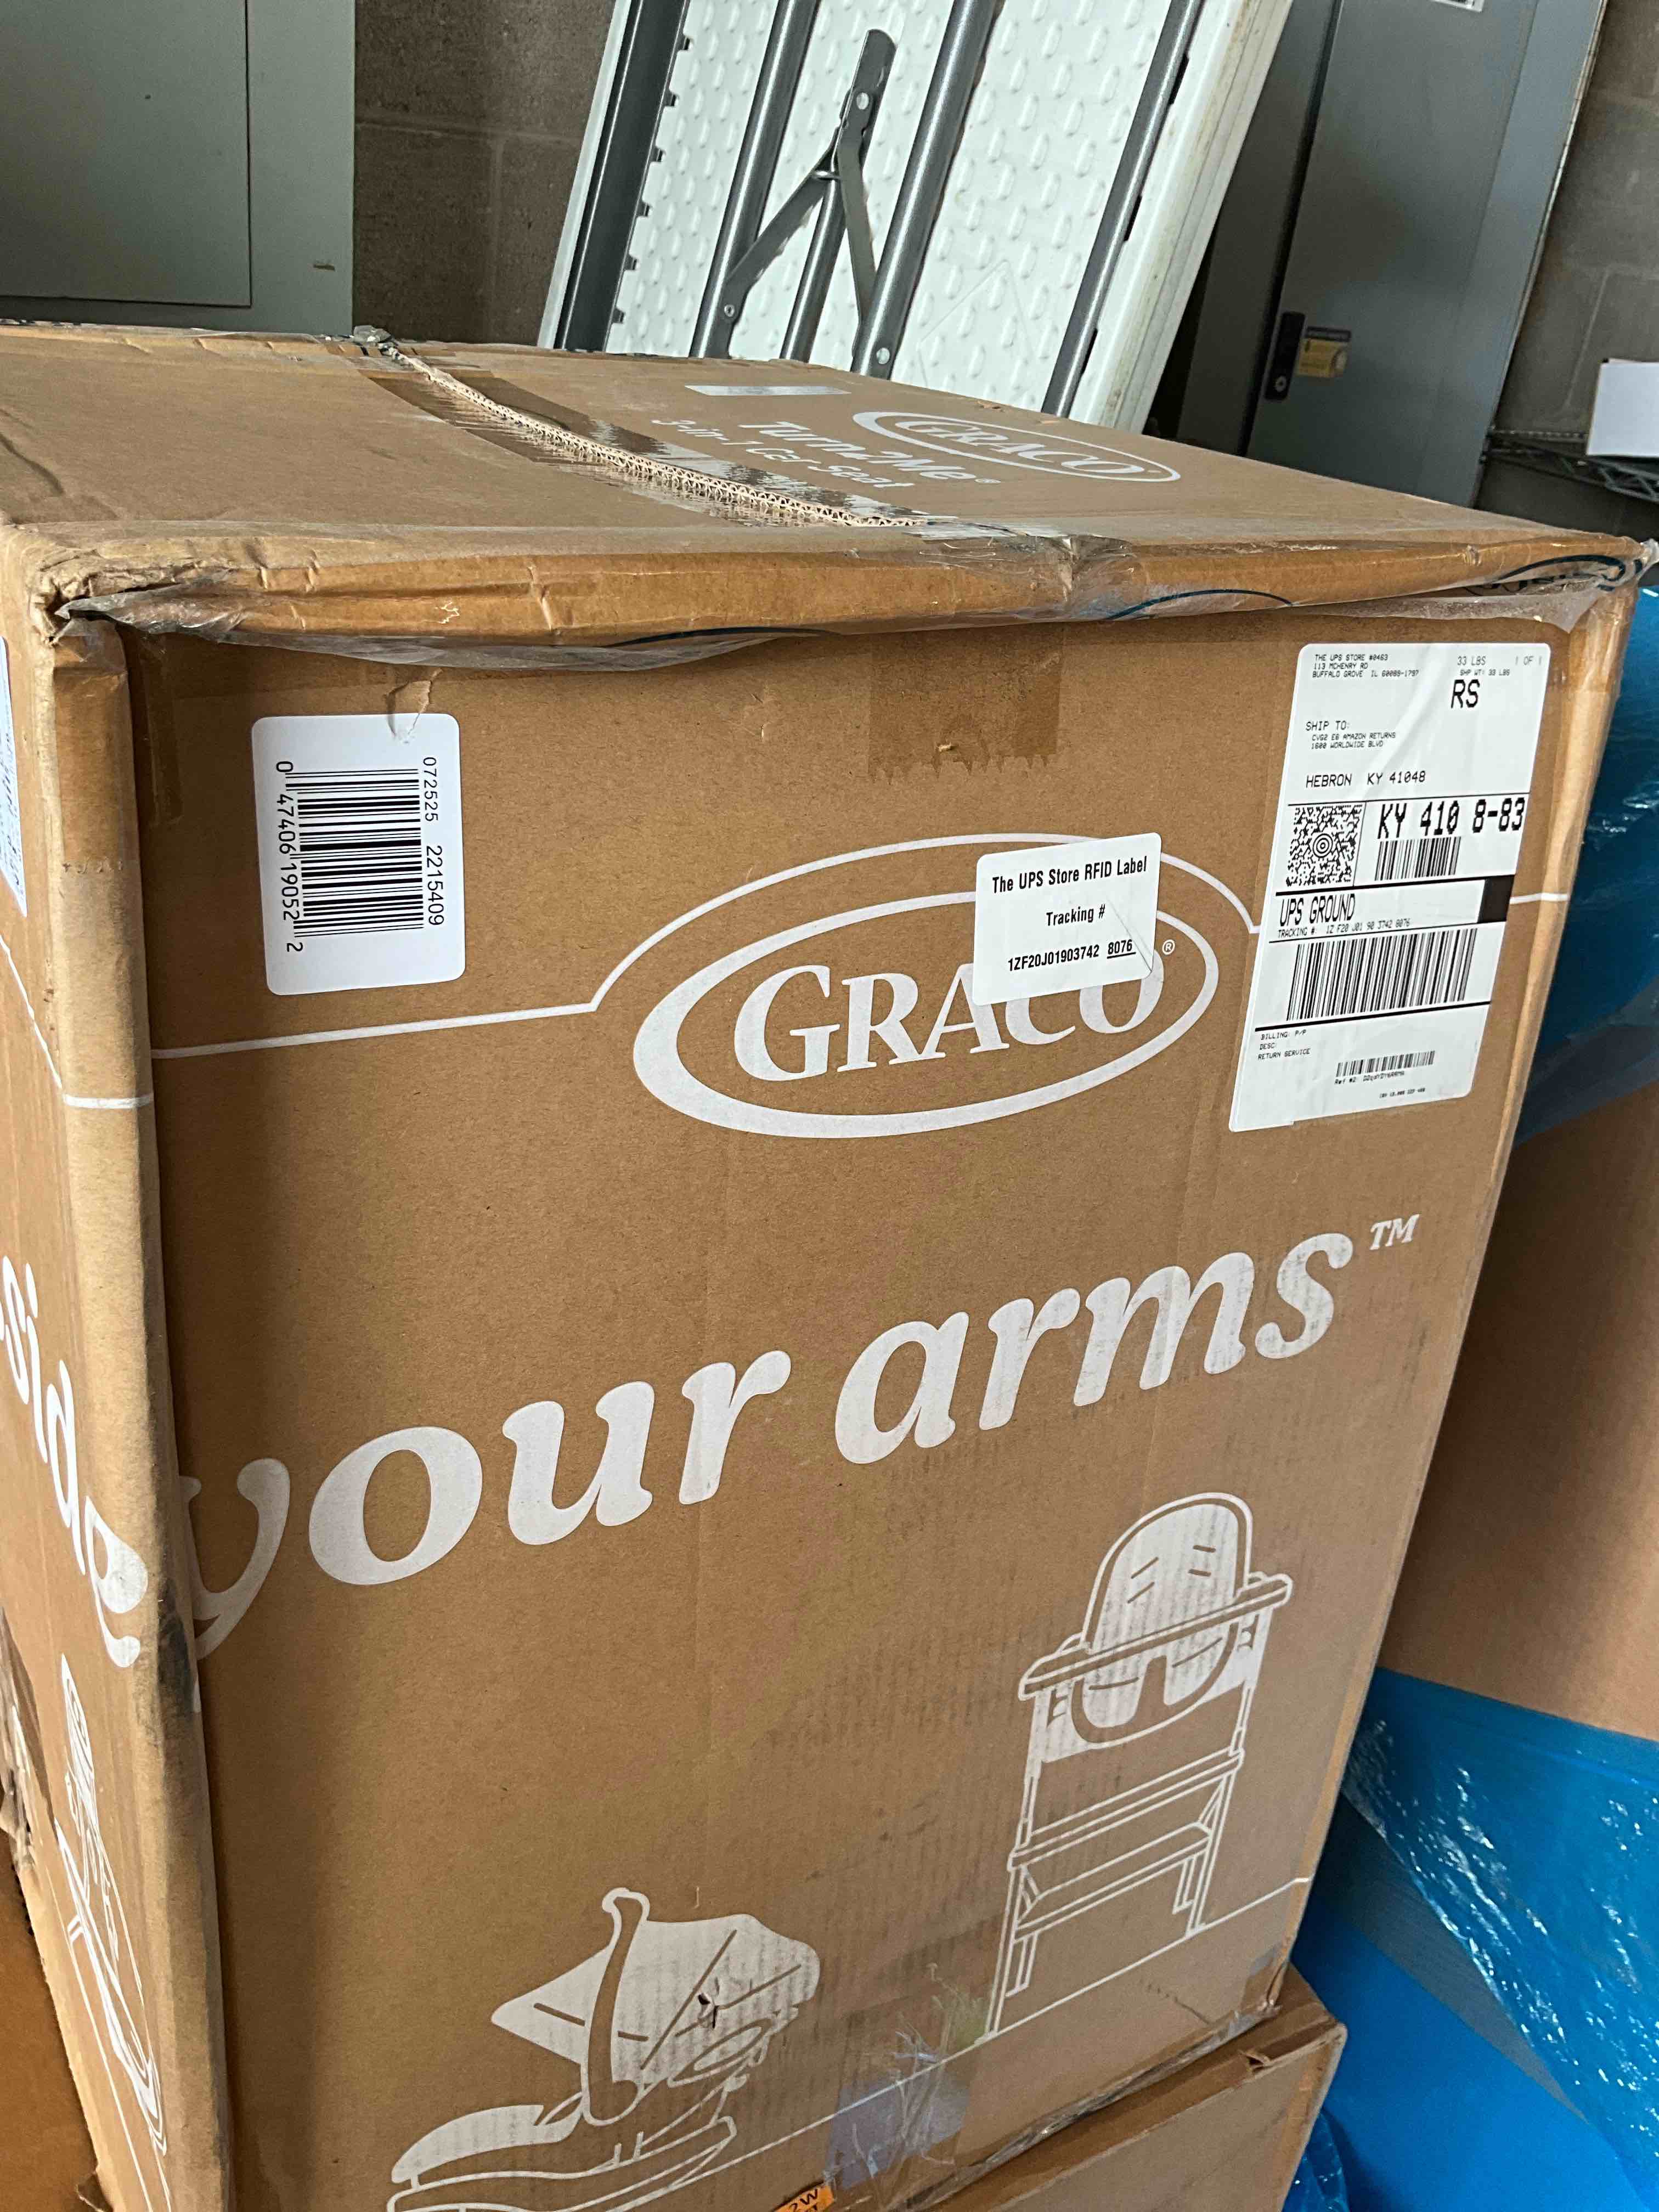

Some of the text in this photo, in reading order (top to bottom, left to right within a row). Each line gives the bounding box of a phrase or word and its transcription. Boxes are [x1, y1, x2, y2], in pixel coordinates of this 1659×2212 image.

[1457, 655, 1486, 666] 33 LBS
[1523, 656, 1534, 665] OF
[1451, 679, 1480, 708] RS
[1306, 720, 1350, 731] SHIP TO:
[1330, 741, 1365, 749] WORLDWIDE
[1306, 770, 1426, 788] HEBRON KY 41048
[1377, 798, 1526, 839] KY 410 8-83
[423, 757, 444, 926] 072525 2215409
[275, 761, 303, 952] 0 47406 19052 2
[992, 855, 1147, 894] The UPS Store RFID Label
[1046, 904, 1105, 927] Tracking #
[1280, 894, 1356, 927] UPS GROUND
[1278, 927, 1308, 939] TRACKING
[1008, 939, 1137, 972] 1ZF20J01903742 8076
[1257, 1048, 1311, 1060] RETURN SERVICE
[178, 1350, 792, 1660] your
